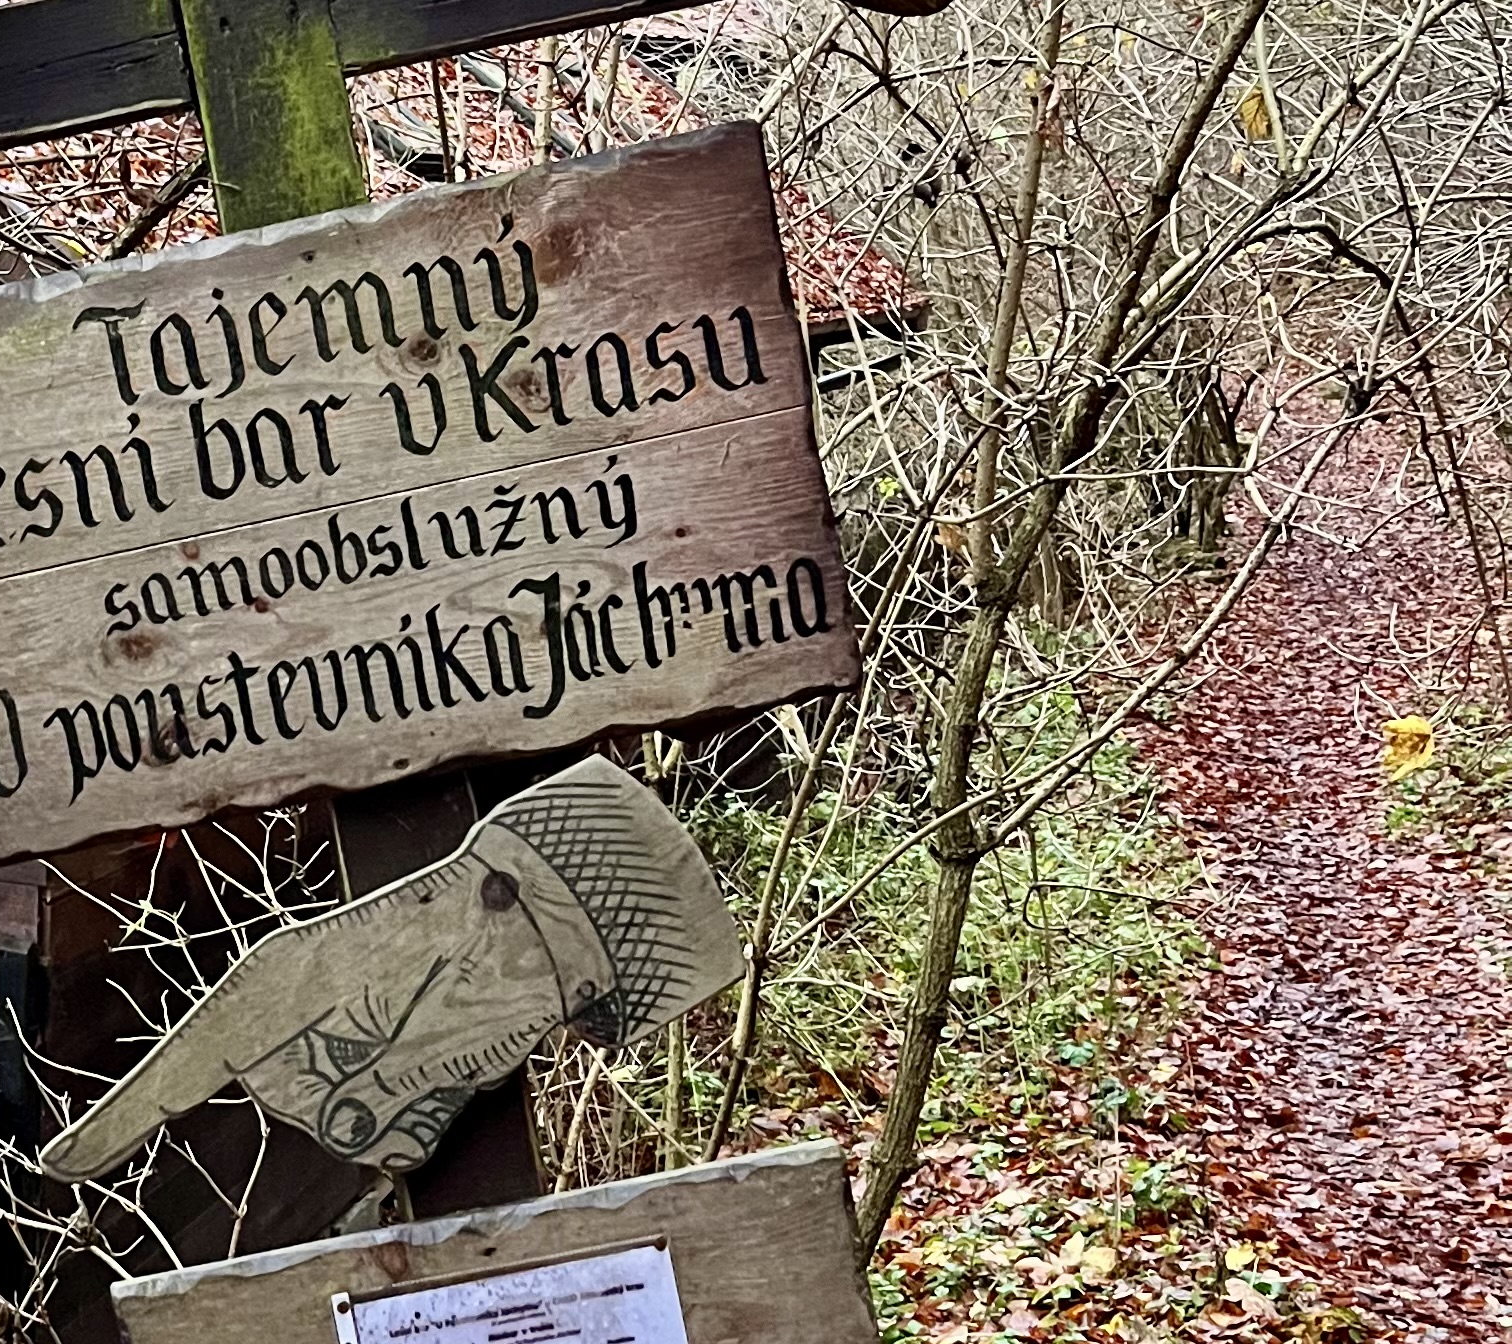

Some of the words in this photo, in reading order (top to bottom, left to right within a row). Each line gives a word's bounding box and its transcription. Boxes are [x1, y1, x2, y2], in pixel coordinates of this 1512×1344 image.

[73, 213, 538, 406] Tajemný
[188, 398, 353, 500] bar
[458, 305, 769, 443] Krasu
[104, 454, 638, 637] samoobslužný
[43, 603, 535, 808] poustevníka
